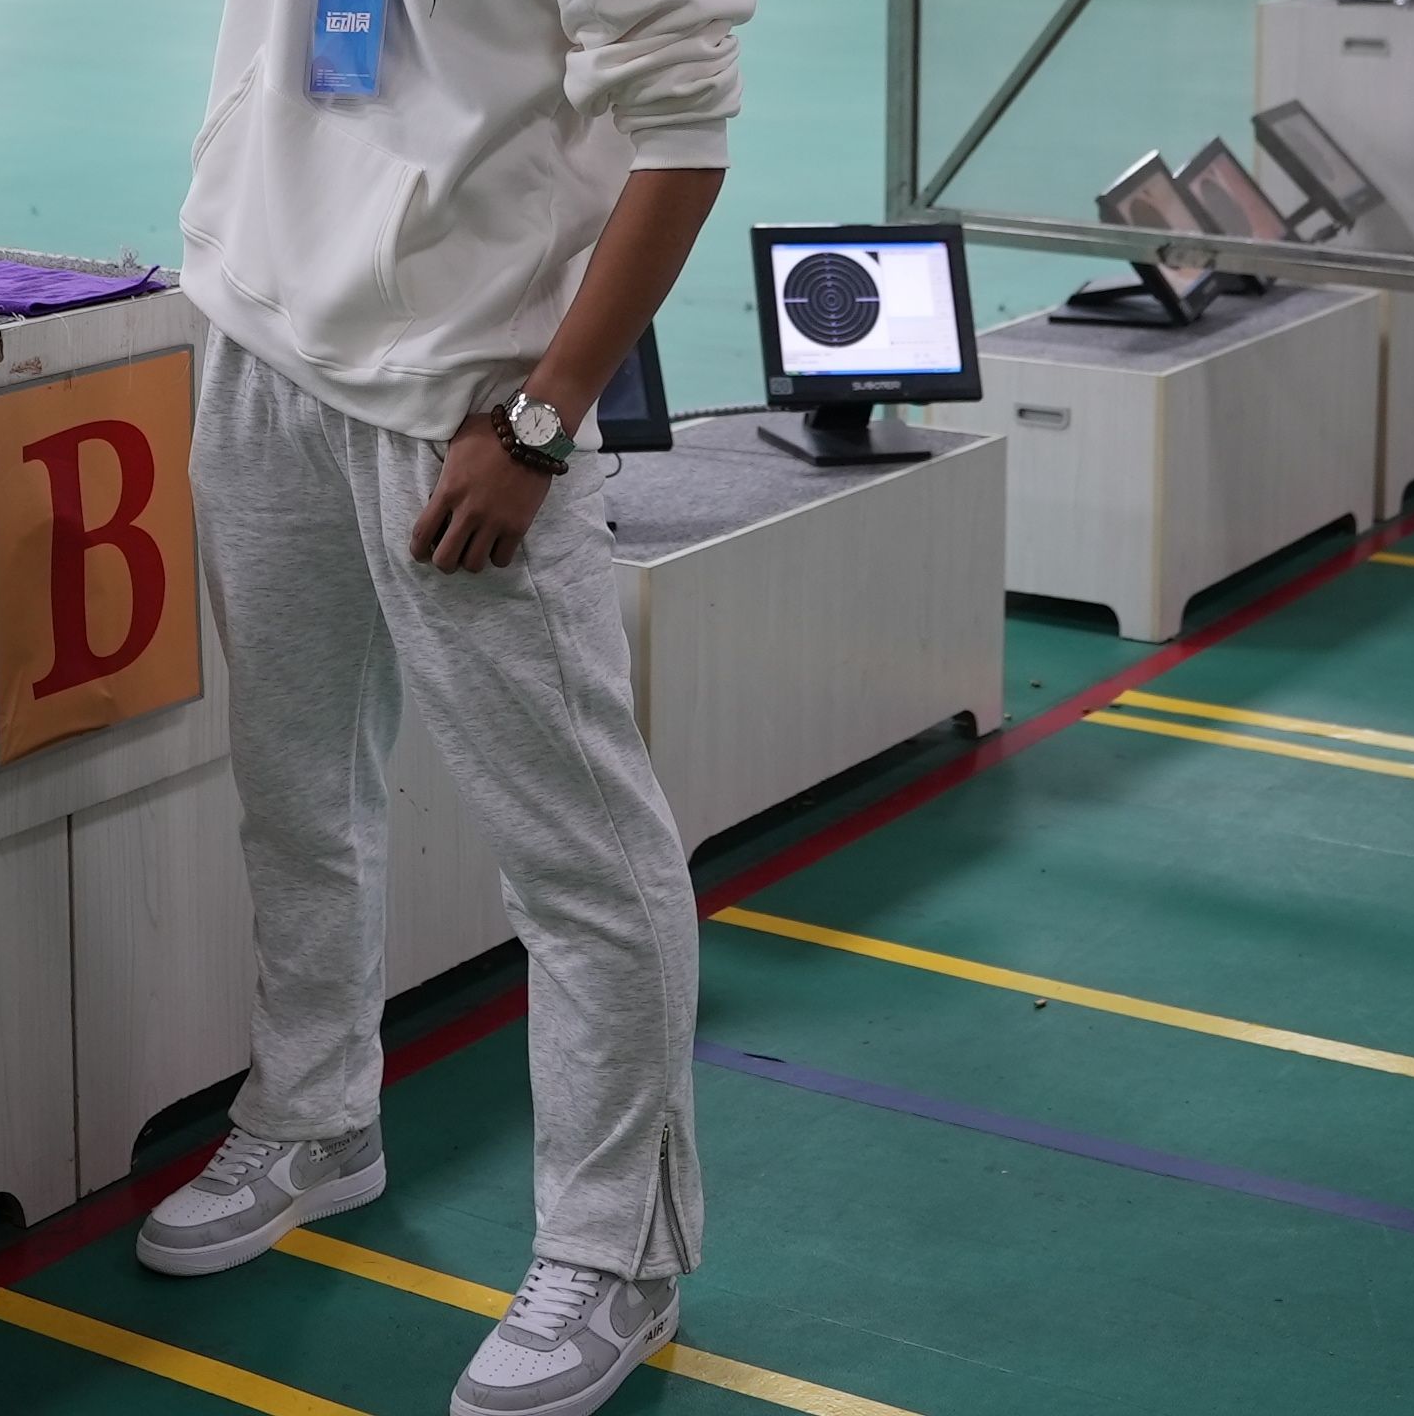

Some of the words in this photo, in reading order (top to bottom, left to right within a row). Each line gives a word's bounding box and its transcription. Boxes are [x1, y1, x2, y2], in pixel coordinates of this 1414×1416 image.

[325, 11, 371, 33] 运动员
[21, 419, 166, 701] B
